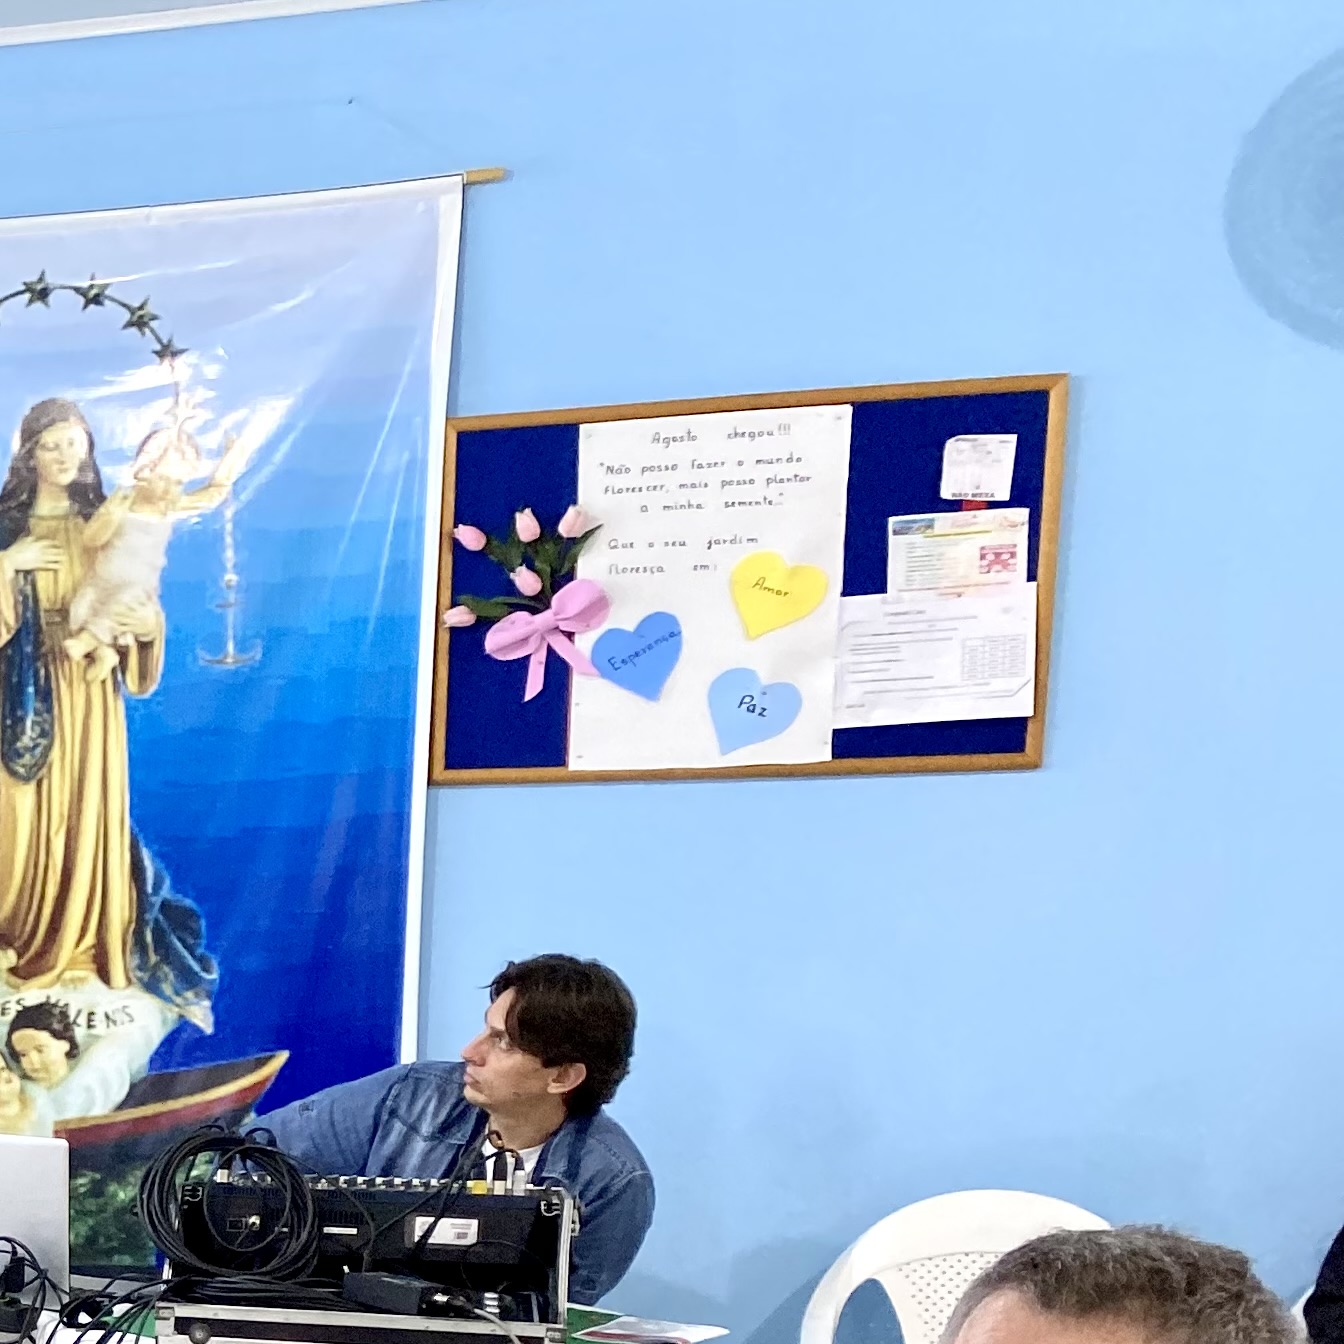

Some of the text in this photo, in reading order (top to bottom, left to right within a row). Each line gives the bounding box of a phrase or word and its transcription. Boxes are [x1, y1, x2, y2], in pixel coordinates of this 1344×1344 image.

[651, 428, 698, 449] Agosto
[641, 463, 679, 476] posso
[691, 459, 726, 471] fazer
[737, 459, 745, 468] o
[755, 452, 803, 465] mundo
[679, 481, 709, 490] mais
[720, 477, 756, 490] posso
[766, 474, 812, 486] plantar
[640, 503, 649, 513] a
[662, 500, 705, 511] minha
[608, 535, 759, 550] Que o seu jardim
[752, 576, 790, 598] Amor
[737, 694, 768, 718] Paz
